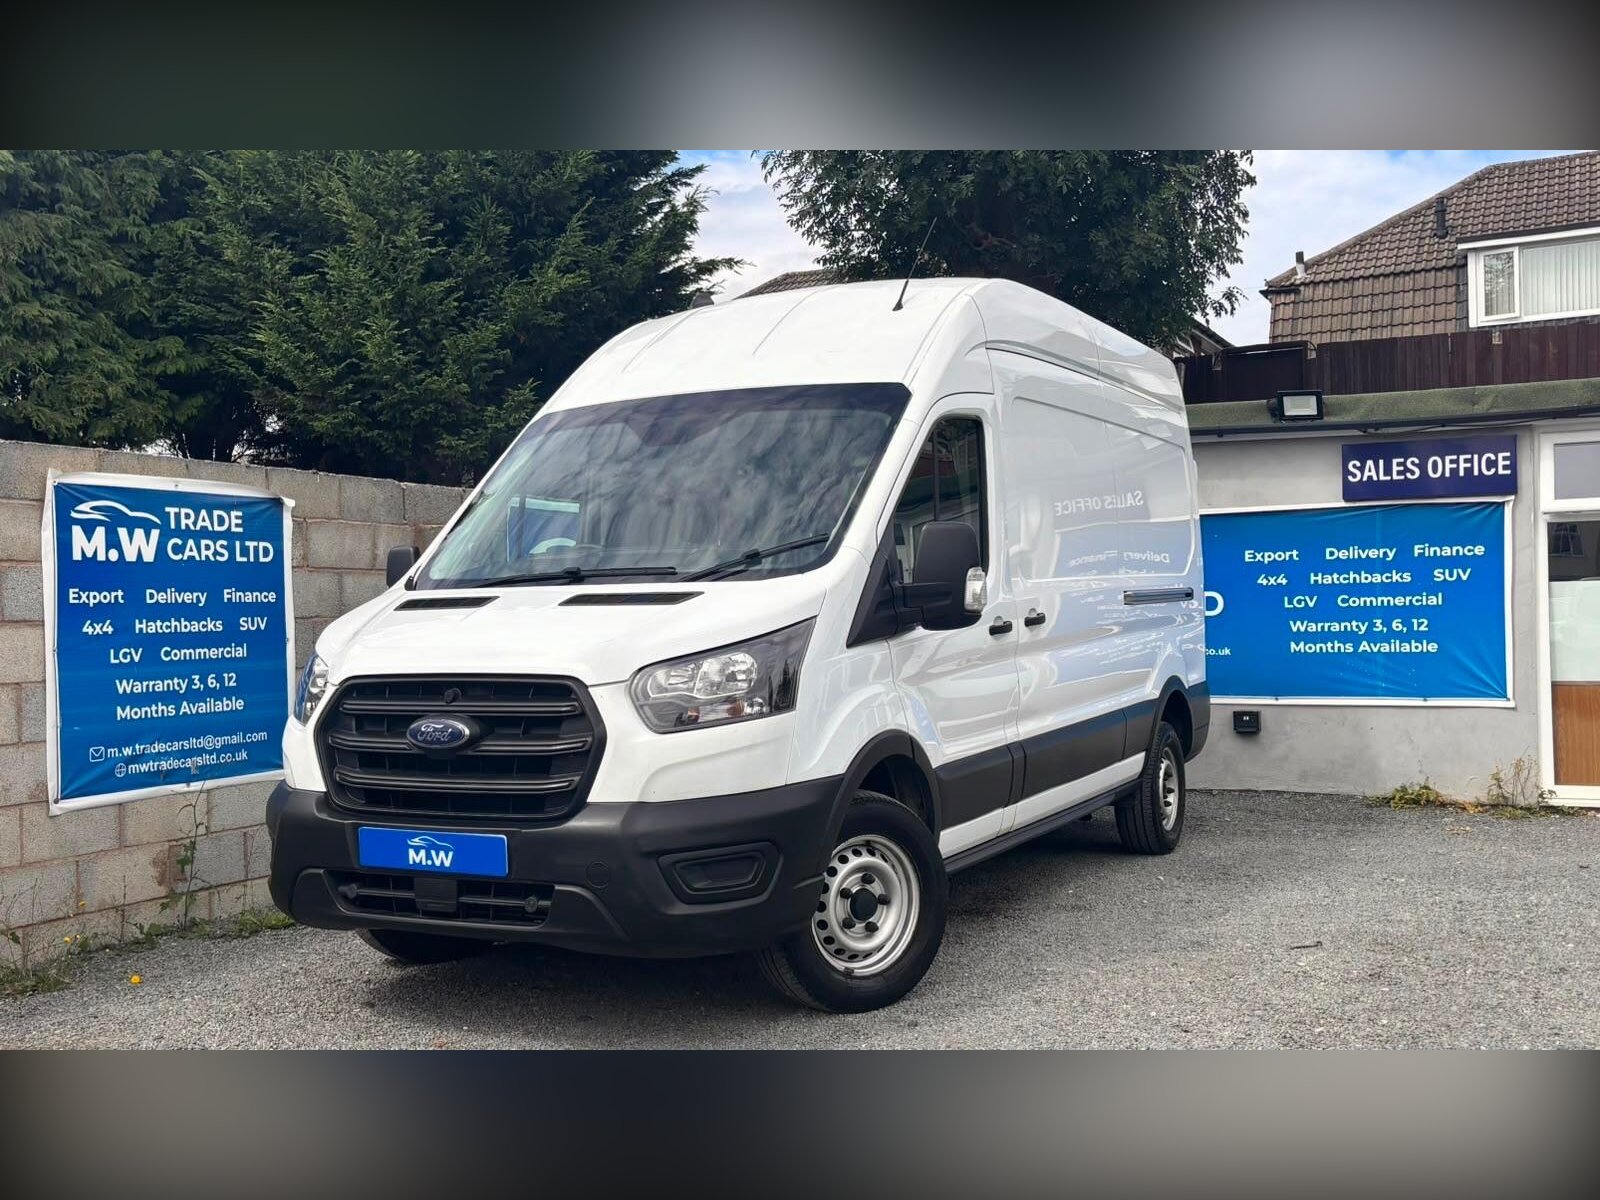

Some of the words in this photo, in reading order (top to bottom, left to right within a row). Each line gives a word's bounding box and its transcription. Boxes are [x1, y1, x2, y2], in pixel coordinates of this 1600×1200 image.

[1348, 457, 1420, 482] SALES
[1428, 452, 1511, 478] OFFICE
[165, 507, 243, 532] TRADE
[71, 525, 160, 562] M.W
[167, 538, 228, 561] CARS
[236, 541, 273, 562] LTD
[1245, 550, 1298, 564] Export
[1326, 546, 1396, 560] Delivery
[1414, 544, 1485, 556] Finance
[1257, 574, 1287, 585] 4x4
[1311, 570, 1411, 584] Hatchbacks
[1434, 569, 1471, 581] SUV
[69, 589, 124, 606] Export
[146, 588, 206, 606] Delivery
[224, 588, 276, 602] Finance
[1285, 596, 1317, 607] LGV
[1338, 593, 1442, 606] Commercial
[83, 620, 113, 635] 4x4
[136, 618, 222, 633] Hatchbacks
[240, 617, 267, 630] SUV
[1290, 621, 1368, 634] Warranty
[1373, 620, 1386, 633] 3,
[1392, 619, 1407, 632] 6,
[1412, 619, 1428, 631] 12
[111, 648, 142, 663] LGV
[161, 643, 246, 661] Commercial
[1291, 641, 1353, 652] Months
[1358, 640, 1438, 652] Available
[116, 678, 188, 694] Warranty
[192, 675, 203, 691] 3,
[208, 674, 219, 689] 6,
[223, 673, 236, 686] 12
[117, 703, 175, 720] Months
[180, 697, 244, 715] Available
[418, 723, 452, 741] Ford
[107, 731, 268, 758] m.w.tradecarsltd@gmail.com
[128, 749, 248, 774] mwtradecarsltd.co.uk
[409, 849, 453, 867] M.W
